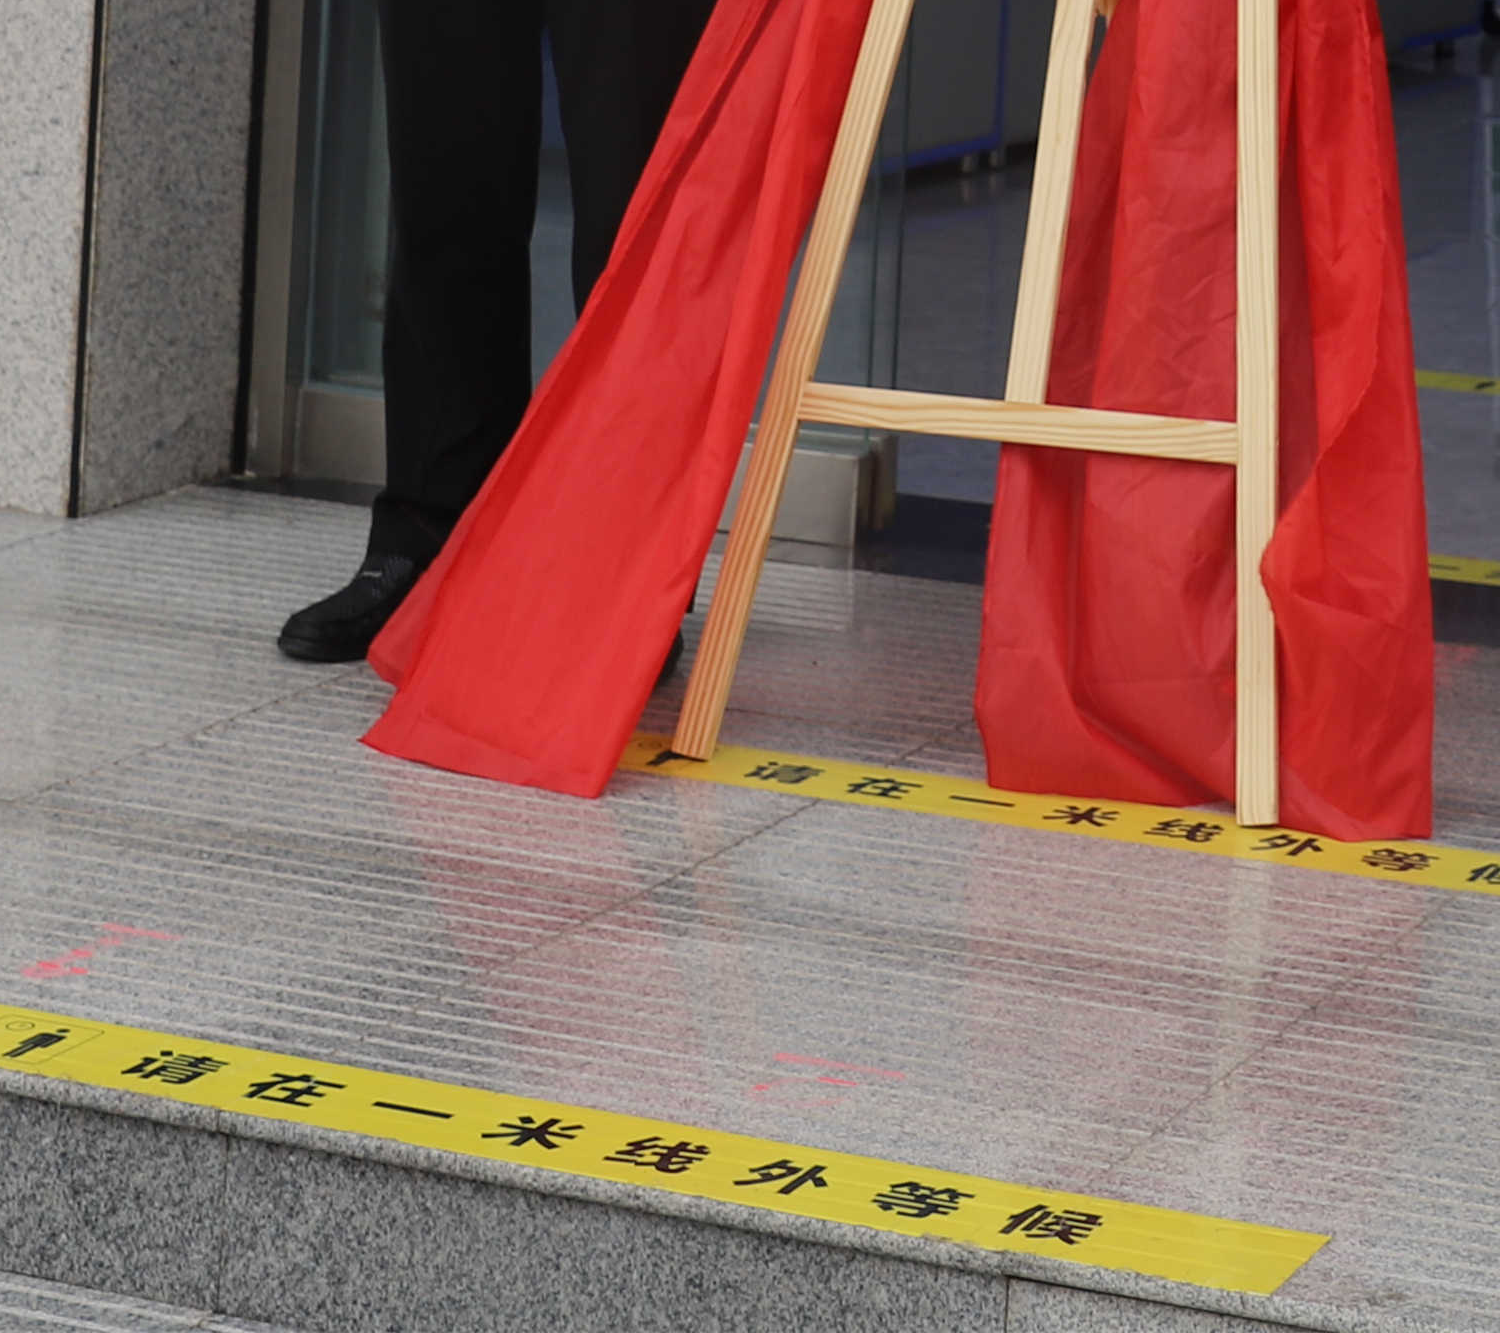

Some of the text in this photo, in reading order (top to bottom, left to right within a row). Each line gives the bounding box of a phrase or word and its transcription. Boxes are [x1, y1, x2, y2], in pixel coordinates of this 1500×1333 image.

[120, 1045, 1106, 1246] 请在一米线外等候
